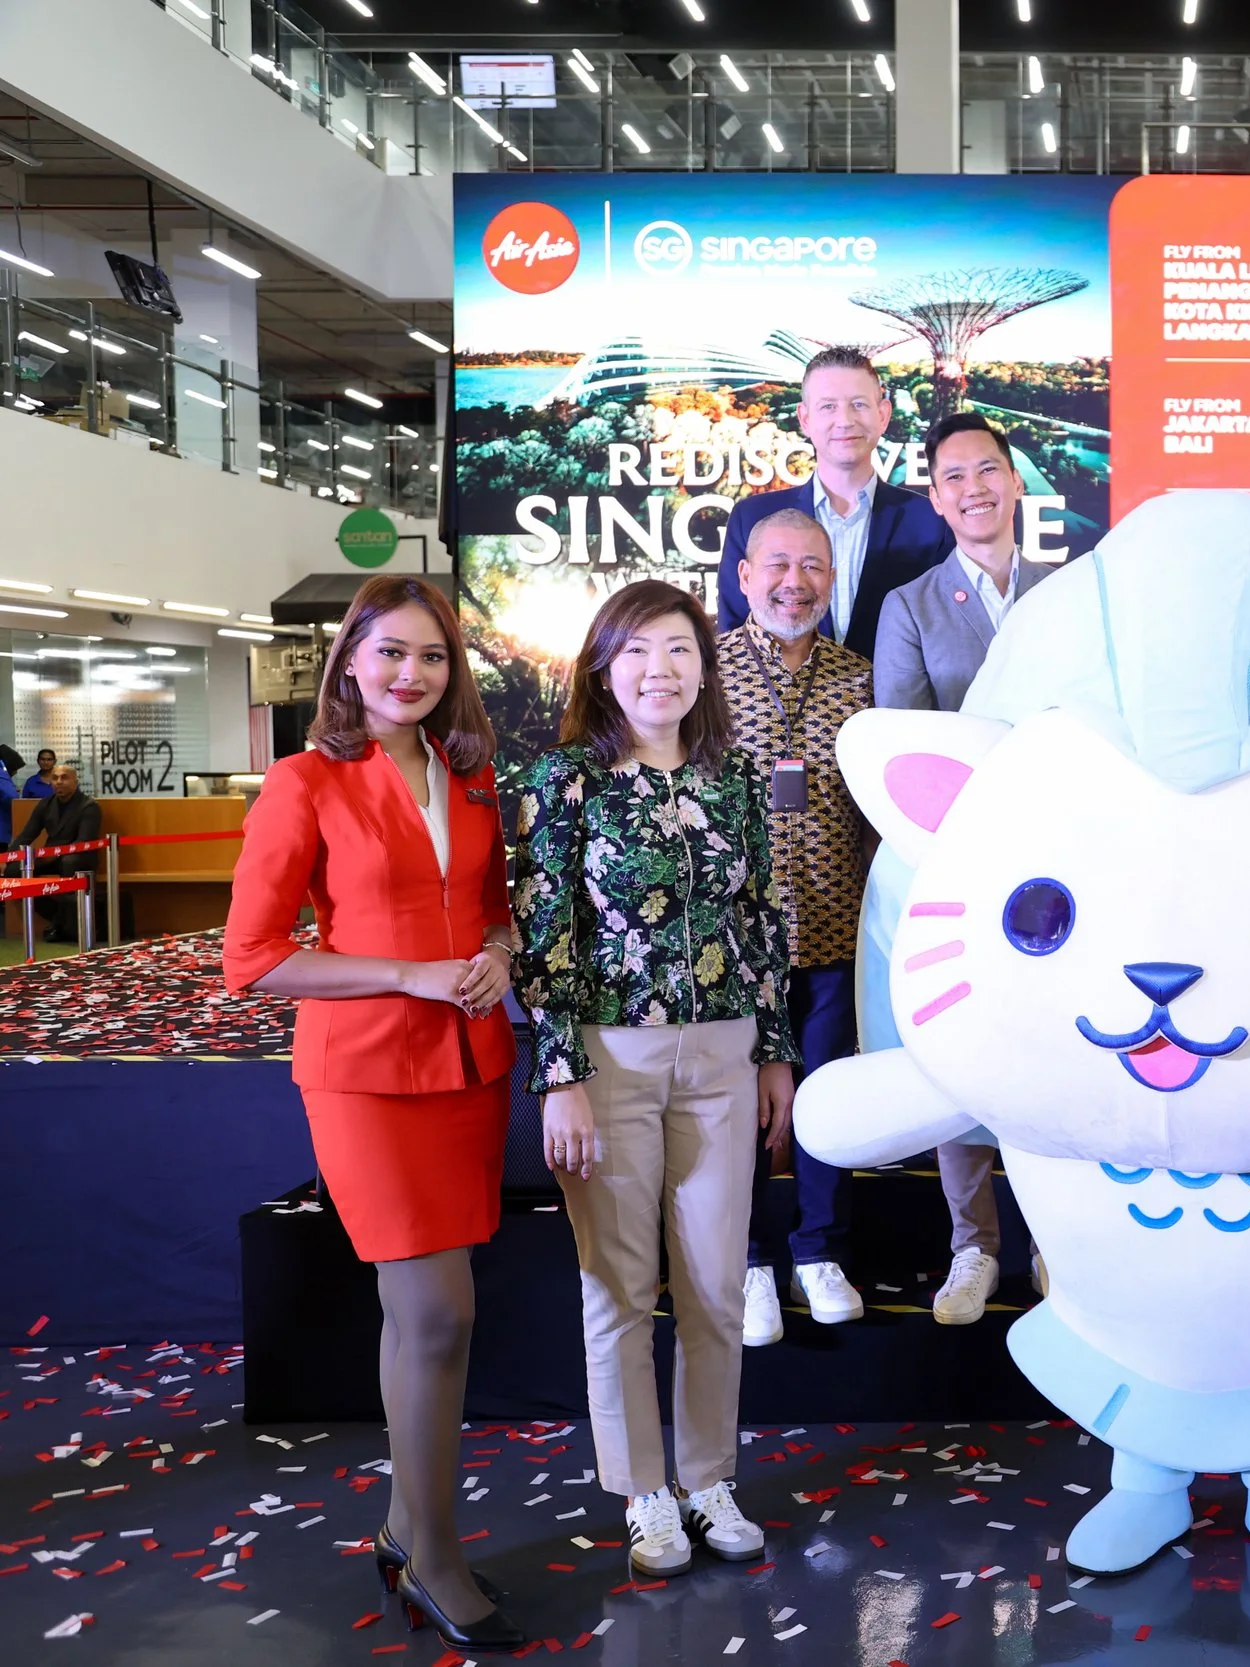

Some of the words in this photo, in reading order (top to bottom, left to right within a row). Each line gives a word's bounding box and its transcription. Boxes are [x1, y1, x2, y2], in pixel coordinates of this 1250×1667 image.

[1164, 245, 1192, 259] FLY
[1193, 245, 1241, 260] FROM
[1164, 262, 1236, 280] KUALA
[1164, 303, 1224, 320] KOTA
[1164, 398, 1192, 412] FLY
[1193, 398, 1241, 413] FROM
[1164, 435, 1213, 454] BALI
[101, 740, 148, 766] PILOT
[102, 769, 153, 794] ROOM
[156, 740, 175, 792] 2
